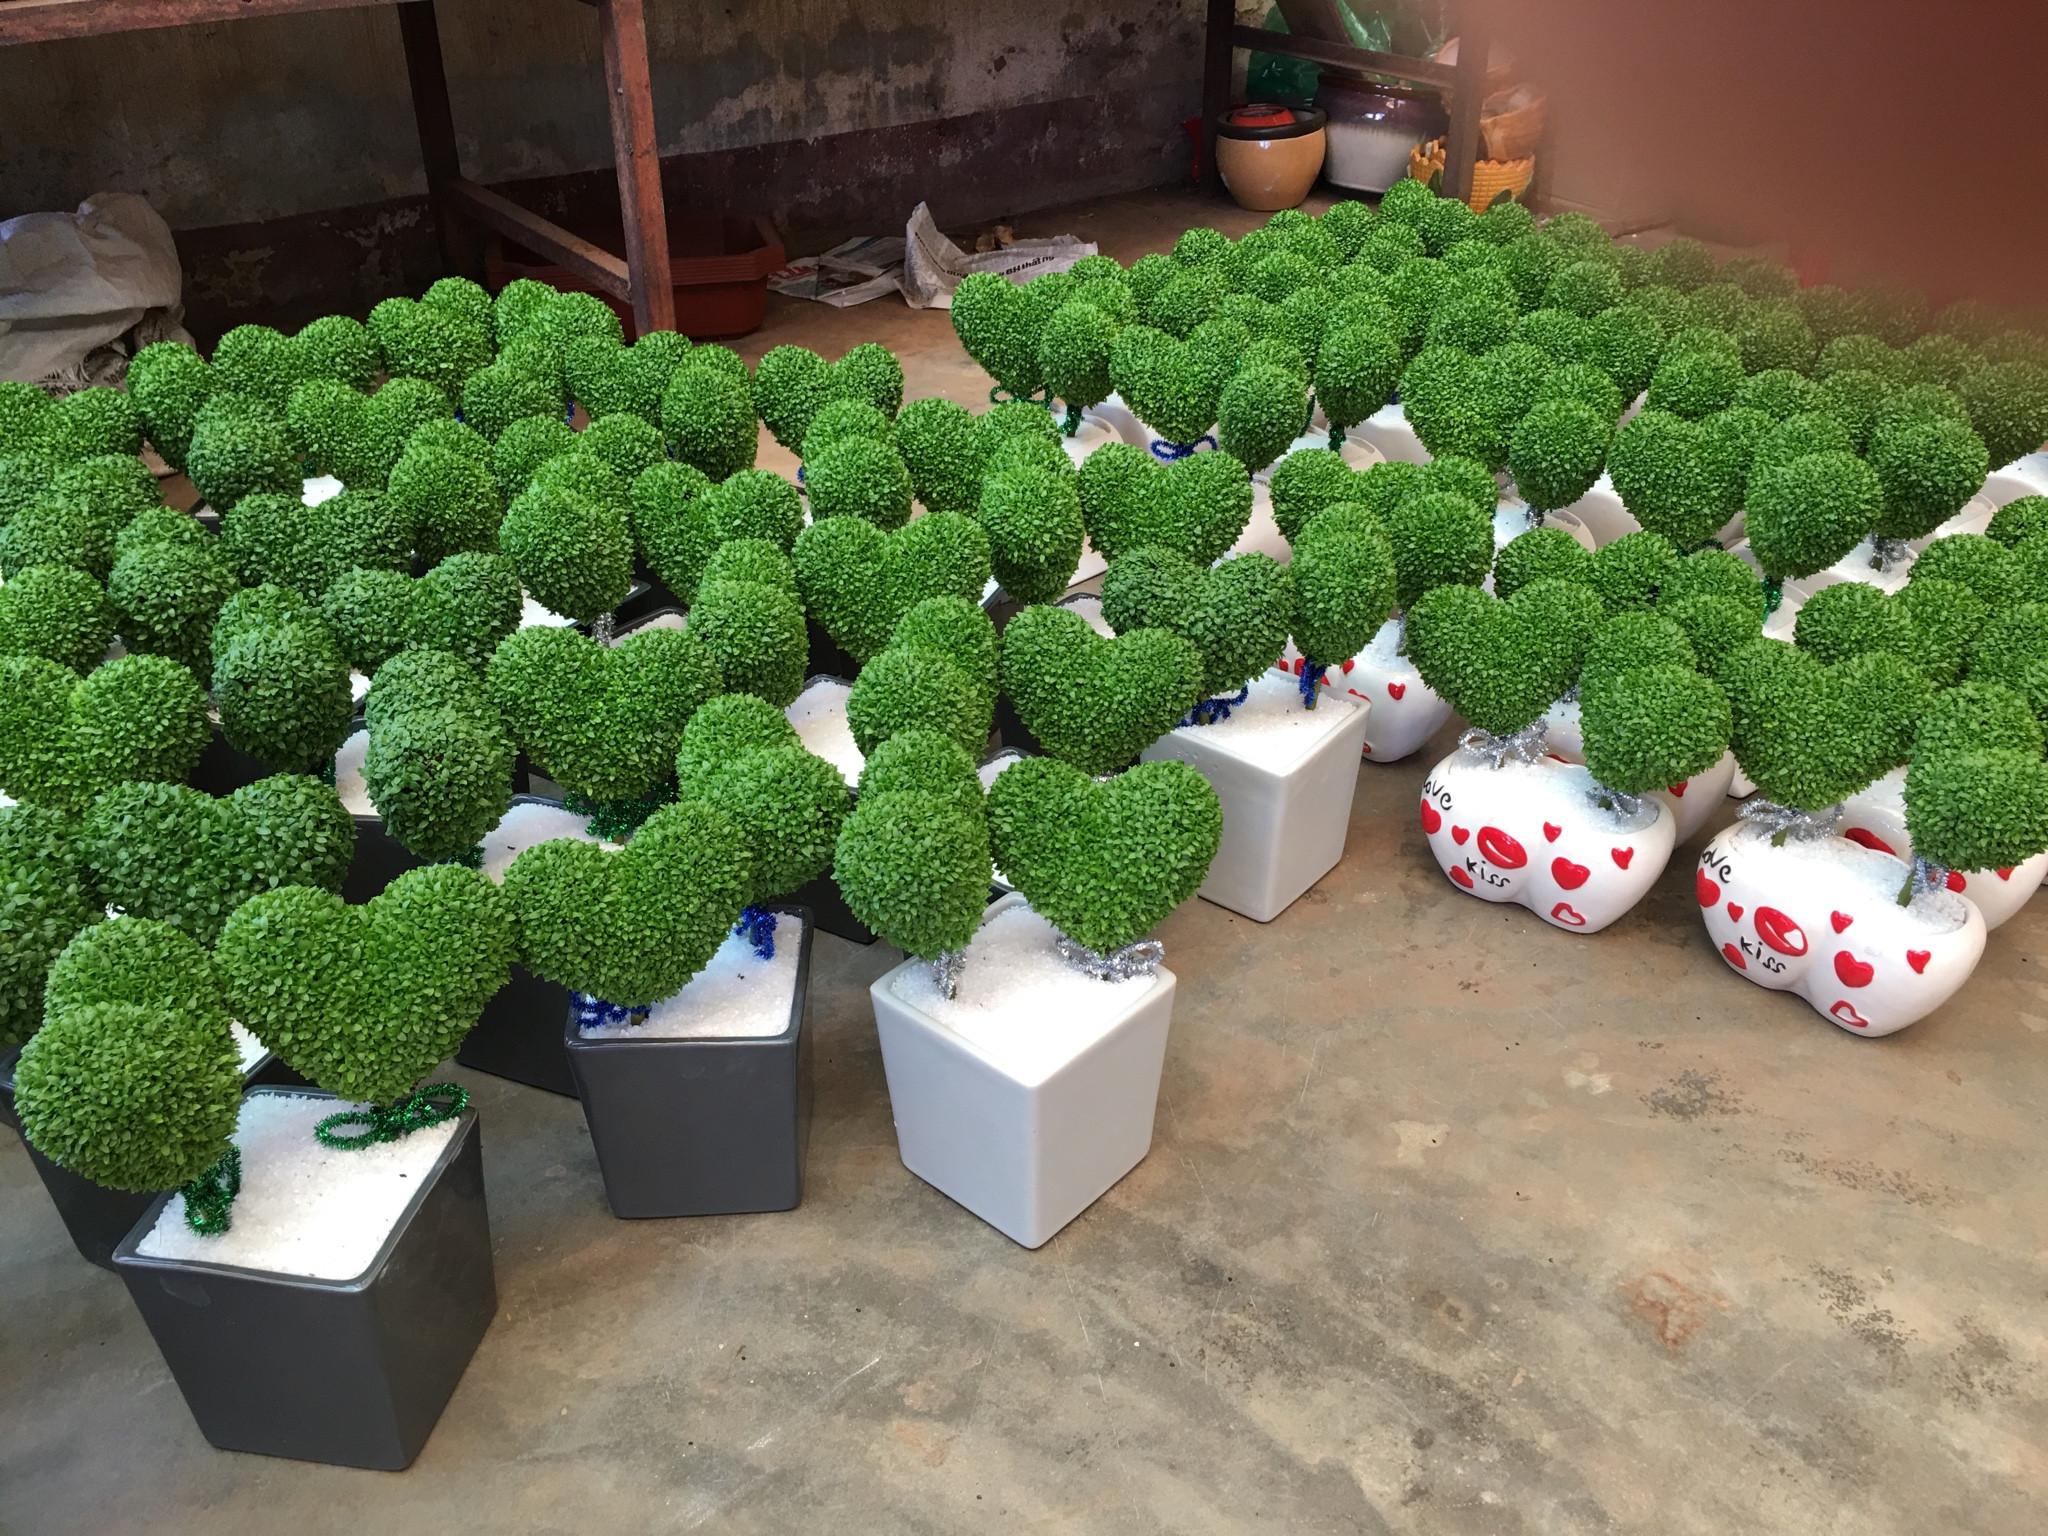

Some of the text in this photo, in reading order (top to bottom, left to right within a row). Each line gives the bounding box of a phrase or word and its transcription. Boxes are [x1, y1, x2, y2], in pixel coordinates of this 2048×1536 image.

[1423, 777, 1453, 811] ove
[1466, 856, 1511, 888] kiss
[1702, 843, 1732, 884] ove
[1740, 935, 1787, 973] kiss
